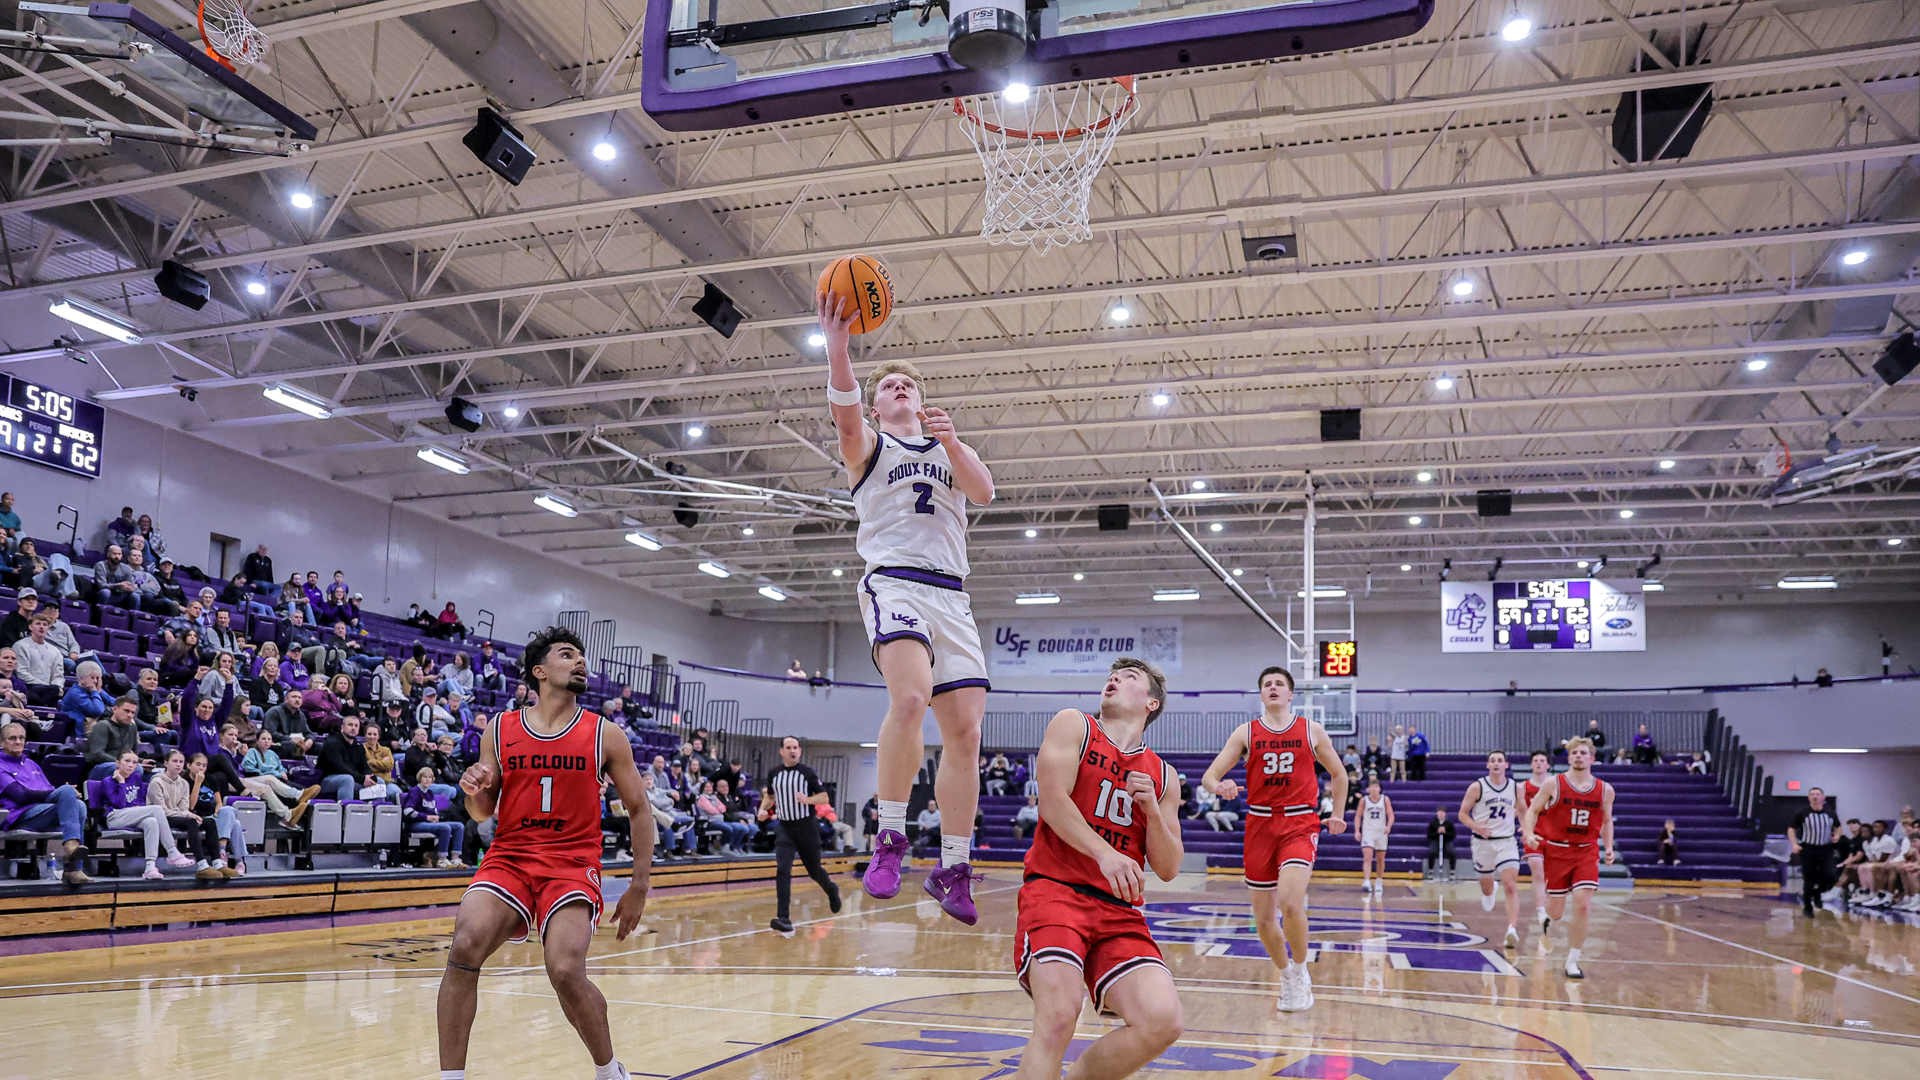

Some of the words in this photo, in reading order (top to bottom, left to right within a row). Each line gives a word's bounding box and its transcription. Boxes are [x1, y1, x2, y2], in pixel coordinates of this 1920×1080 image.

[864, 281, 881, 319] NCAA
[26, 385, 72, 421] 5:05
[33, 433, 46, 454] 2
[70, 442, 98, 472] 62
[888, 462, 921, 485] SIOUX
[912, 482, 935, 515] 2
[1528, 581, 1565, 598] 5:05
[891, 612, 918, 628] USF
[1446, 608, 1487, 634] USF
[1499, 608, 1521, 625] 69
[1536, 609, 1547, 623] 2
[1566, 607, 1589, 624] 62
[995, 627, 1031, 658] USF
[1038, 638, 1094, 653] COUGAR
[1099, 637, 1135, 653] CLUB
[1575, 629, 1590, 643] 10
[1327, 642, 1355, 656] 5:05
[1324, 654, 1351, 676] 28
[1270, 740, 1302, 749] CLOUD
[507, 755, 528, 770] ST.
[531, 755, 586, 771] CLOUD
[1087, 750, 1107, 770] ST.
[1262, 751, 1295, 775] 32
[539, 775, 553, 814] 1
[1094, 778, 1134, 827] 10
[1489, 806, 1506, 819] 24
[1571, 808, 1590, 826] 12
